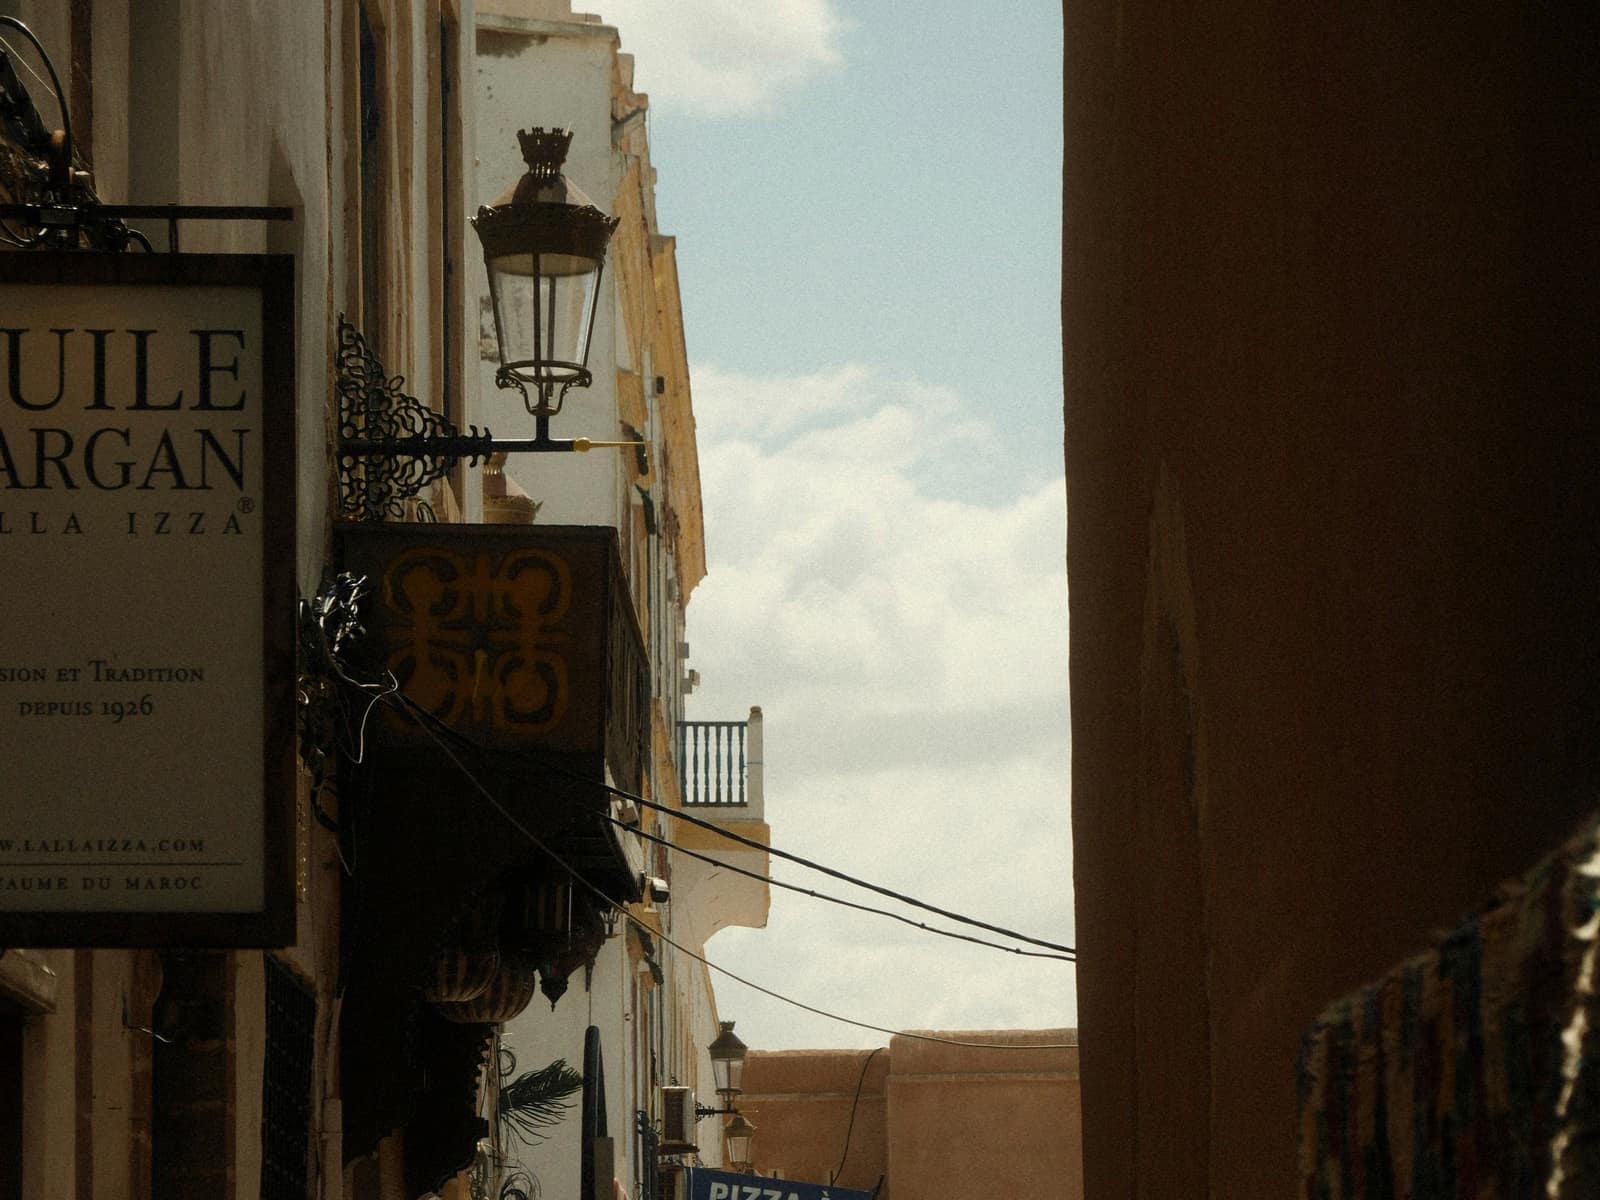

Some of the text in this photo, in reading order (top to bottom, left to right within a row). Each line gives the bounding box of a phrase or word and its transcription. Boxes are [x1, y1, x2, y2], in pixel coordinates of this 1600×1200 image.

[19, 694, 154, 724] DEPUIS 1926
[82, 877, 112, 891] DU
[125, 876, 202, 891] MAROC
